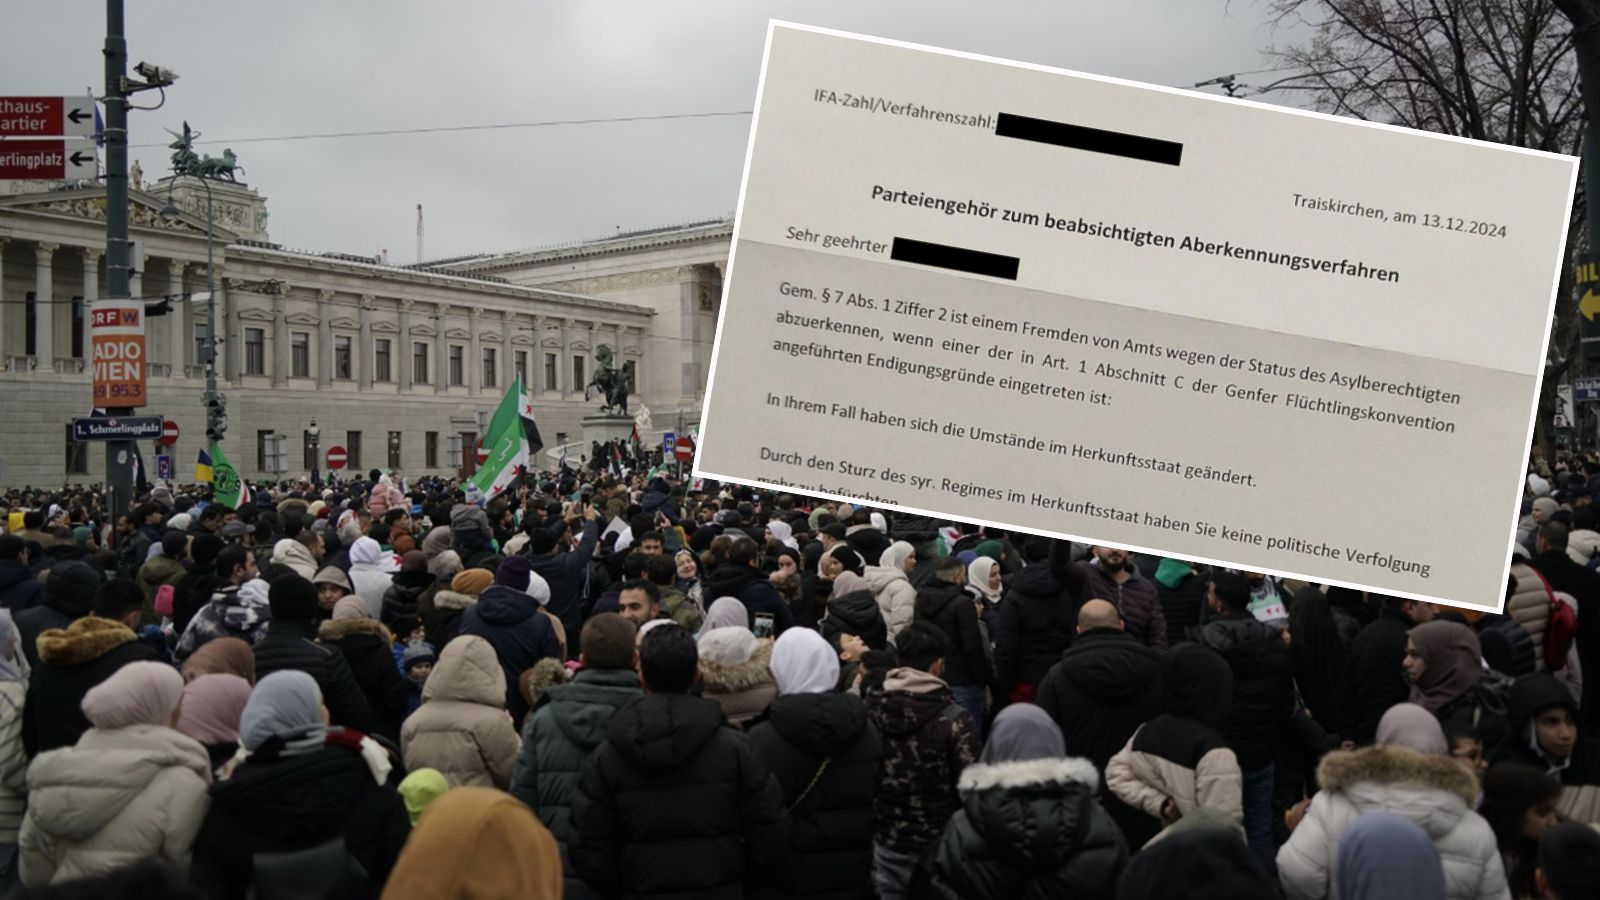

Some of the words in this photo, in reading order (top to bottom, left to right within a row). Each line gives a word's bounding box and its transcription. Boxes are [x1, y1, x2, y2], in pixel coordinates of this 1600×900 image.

[813, 88, 996, 130] IFA-Zahl/Verfahrenszahl:
[785, 225, 821, 243] Sehr
[822, 234, 889, 254] geehrter
[871, 184, 999, 219] Parteiengehör
[1001, 208, 1040, 227] zum
[1043, 211, 1176, 249] beabsichtigten
[1178, 235, 1400, 284] Aberkennungsverfahren
[1292, 193, 1389, 223] Traiskirchen,
[1392, 211, 1417, 225] am
[1421, 213, 1507, 239] 13.12.2024
[772, 340, 863, 365] angeführten
[866, 352, 995, 387] Endigungsgründe
[998, 375, 1086, 402] eingetreten
[1089, 389, 1113, 406] ist:
[775, 309, 884, 342] abzuerkennen,
[892, 331, 934, 348] wenn
[941, 338, 981, 356] einer
[987, 344, 1014, 361] der
[1020, 349, 1035, 365] in
[1041, 353, 1069, 371] Art.
[1078, 359, 1087, 374] 1
[1094, 362, 1167, 387] Abschnitt
[1173, 375, 1185, 390] C
[1191, 377, 1218, 394] der
[1224, 383, 1279, 405] Genfer
[1285, 393, 1456, 434] Flüchtlingskonvention
[779, 281, 817, 301] Gem.
[821, 287, 831, 304] §
[834, 290, 845, 304] 7
[845, 292, 878, 310] Abs.
[882, 298, 891, 313] 1
[893, 299, 936, 319] Ziffer
[937, 307, 948, 322] 2
[950, 309, 969, 326] ist
[971, 313, 1018, 334] einem
[1022, 321, 1089, 345] Fremden
[1092, 335, 1120, 350] von
[1122, 338, 1163, 357] Amts
[1165, 347, 1216, 366] wegen
[1218, 353, 1246, 370] der
[1247, 358, 1296, 379] Status
[1299, 366, 1326, 384] des
[1328, 371, 1461, 405] Asylberechtigten
[766, 392, 781, 407] In
[784, 394, 827, 415] Ihrem
[830, 403, 857, 420] Fall
[859, 407, 906, 428] haben
[909, 416, 939, 434] sich
[942, 421, 966, 438] die
[969, 426, 1046, 452] Umstände
[1048, 439, 1068, 456] im
[1071, 443, 1182, 475] Herkunftsstaat
[1183, 465, 1257, 488] geändert.
[759, 446, 803, 467] Durch
[806, 455, 835, 472] den
[838, 460, 877, 479] Sturz
[880, 467, 907, 484] des
[909, 475, 936, 491] syr.
[940, 477, 1003, 501] Regimes
[1007, 488, 1026, 505] im
[1030, 492, 1140, 525] Herkunftsstaat
[1143, 511, 1190, 533] haben
[1194, 521, 1217, 538] Sie
[1220, 524, 1263, 546] keine
[1266, 536, 1341, 560] politische
[1345, 547, 1431, 579] Verfolgung
